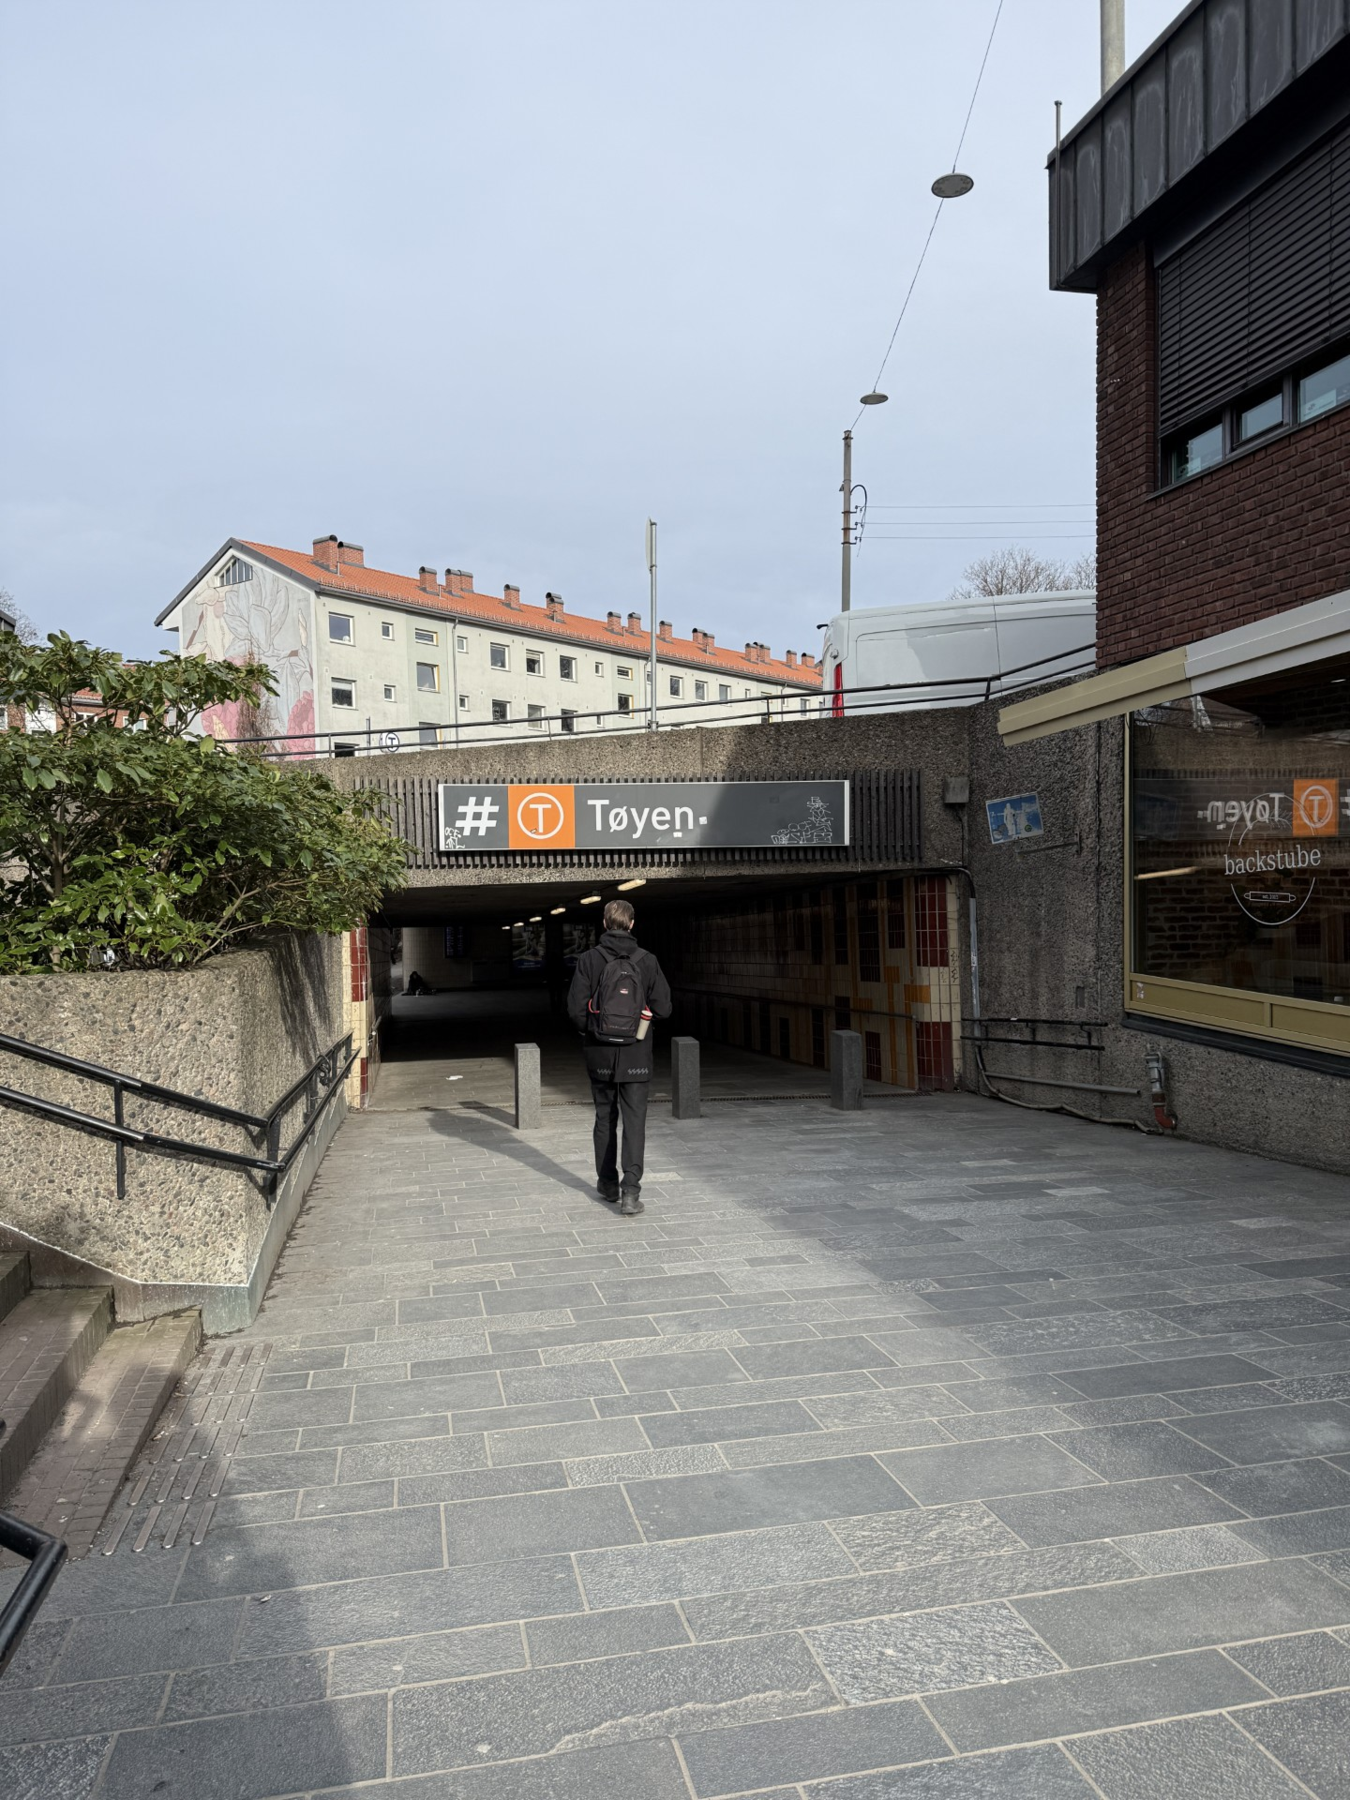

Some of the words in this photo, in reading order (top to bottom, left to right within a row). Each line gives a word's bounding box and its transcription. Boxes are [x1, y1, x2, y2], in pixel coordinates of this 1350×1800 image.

[529, 804, 552, 833] T
[587, 799, 694, 839] Tøyen
[1224, 844, 1321, 876] backstube
